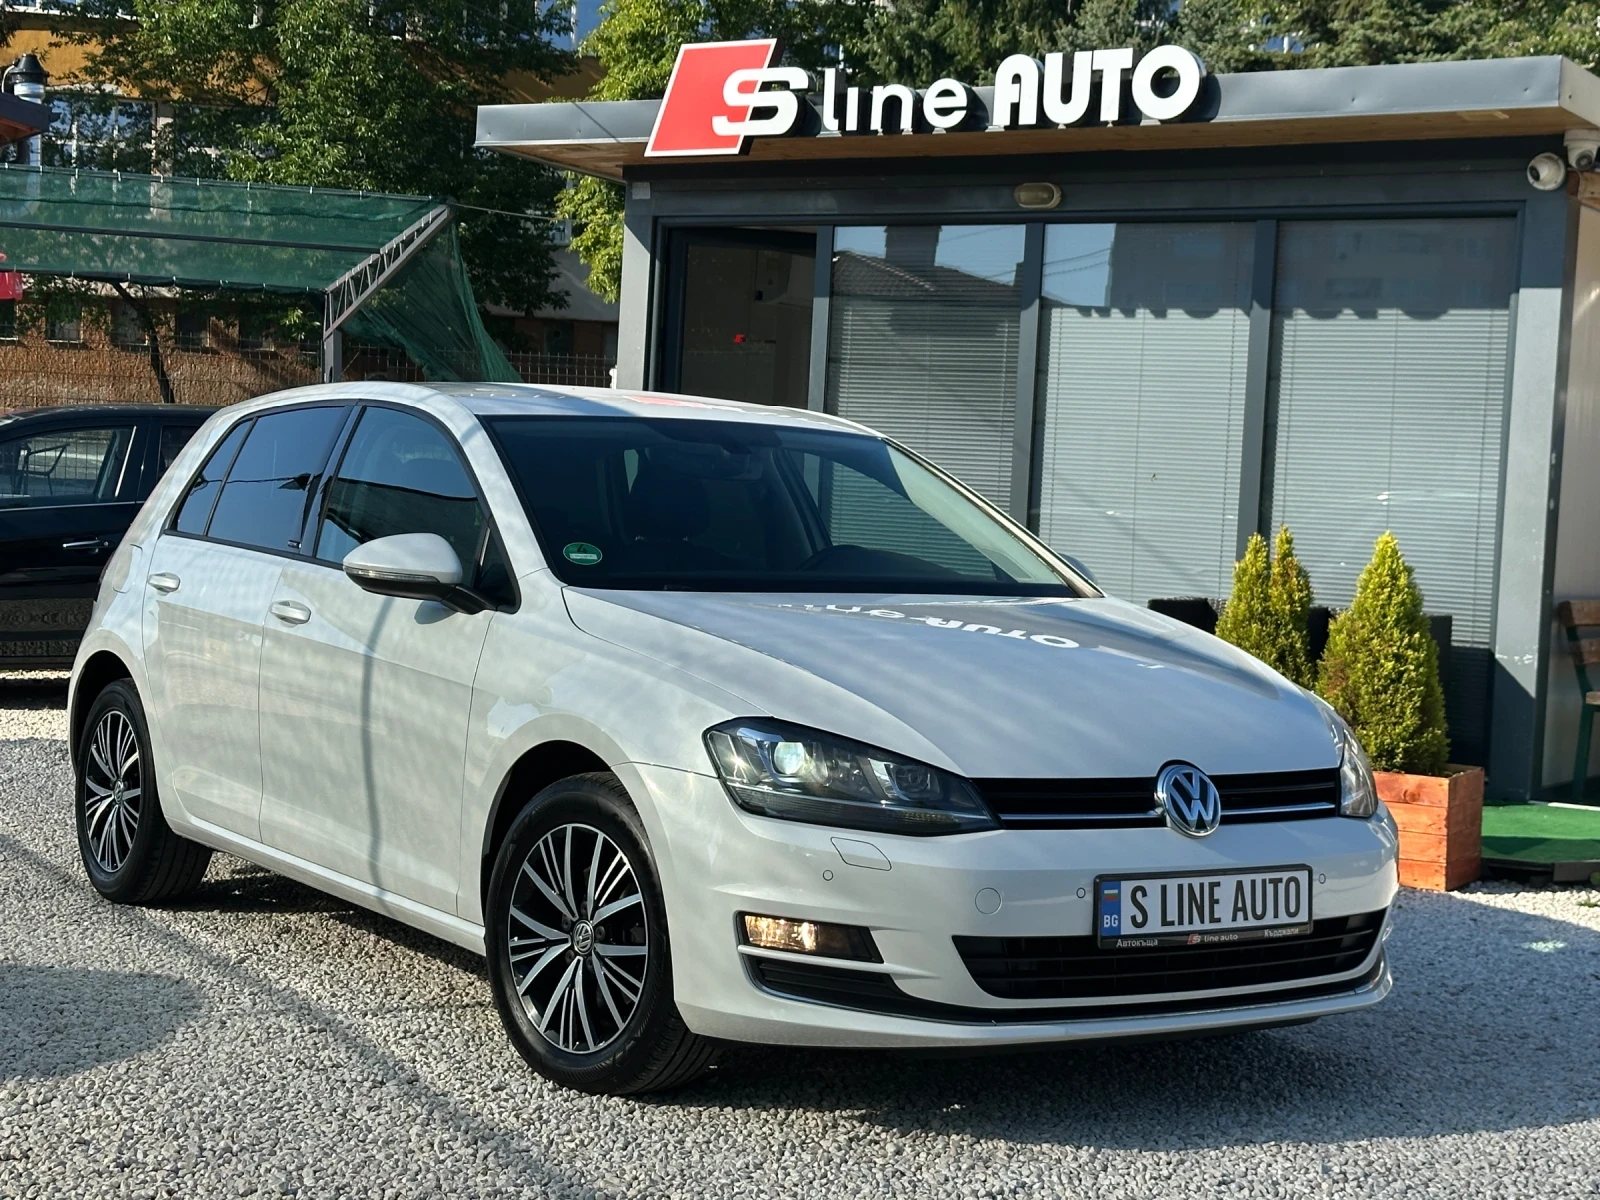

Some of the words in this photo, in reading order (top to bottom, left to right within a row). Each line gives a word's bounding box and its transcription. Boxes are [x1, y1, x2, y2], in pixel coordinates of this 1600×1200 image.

[711, 66, 809, 136] S
[824, 67, 968, 132] line
[992, 44, 1201, 127] AUTO
[1158, 765, 1221, 836] VW
[1130, 885, 1149, 929] S
[1160, 881, 1222, 927] LINE
[1231, 876, 1301, 922] AUTO
[1103, 914, 1119, 928] BG
[1115, 938, 1158, 948] Автокъща
[1220, 934, 1239, 942] auto
